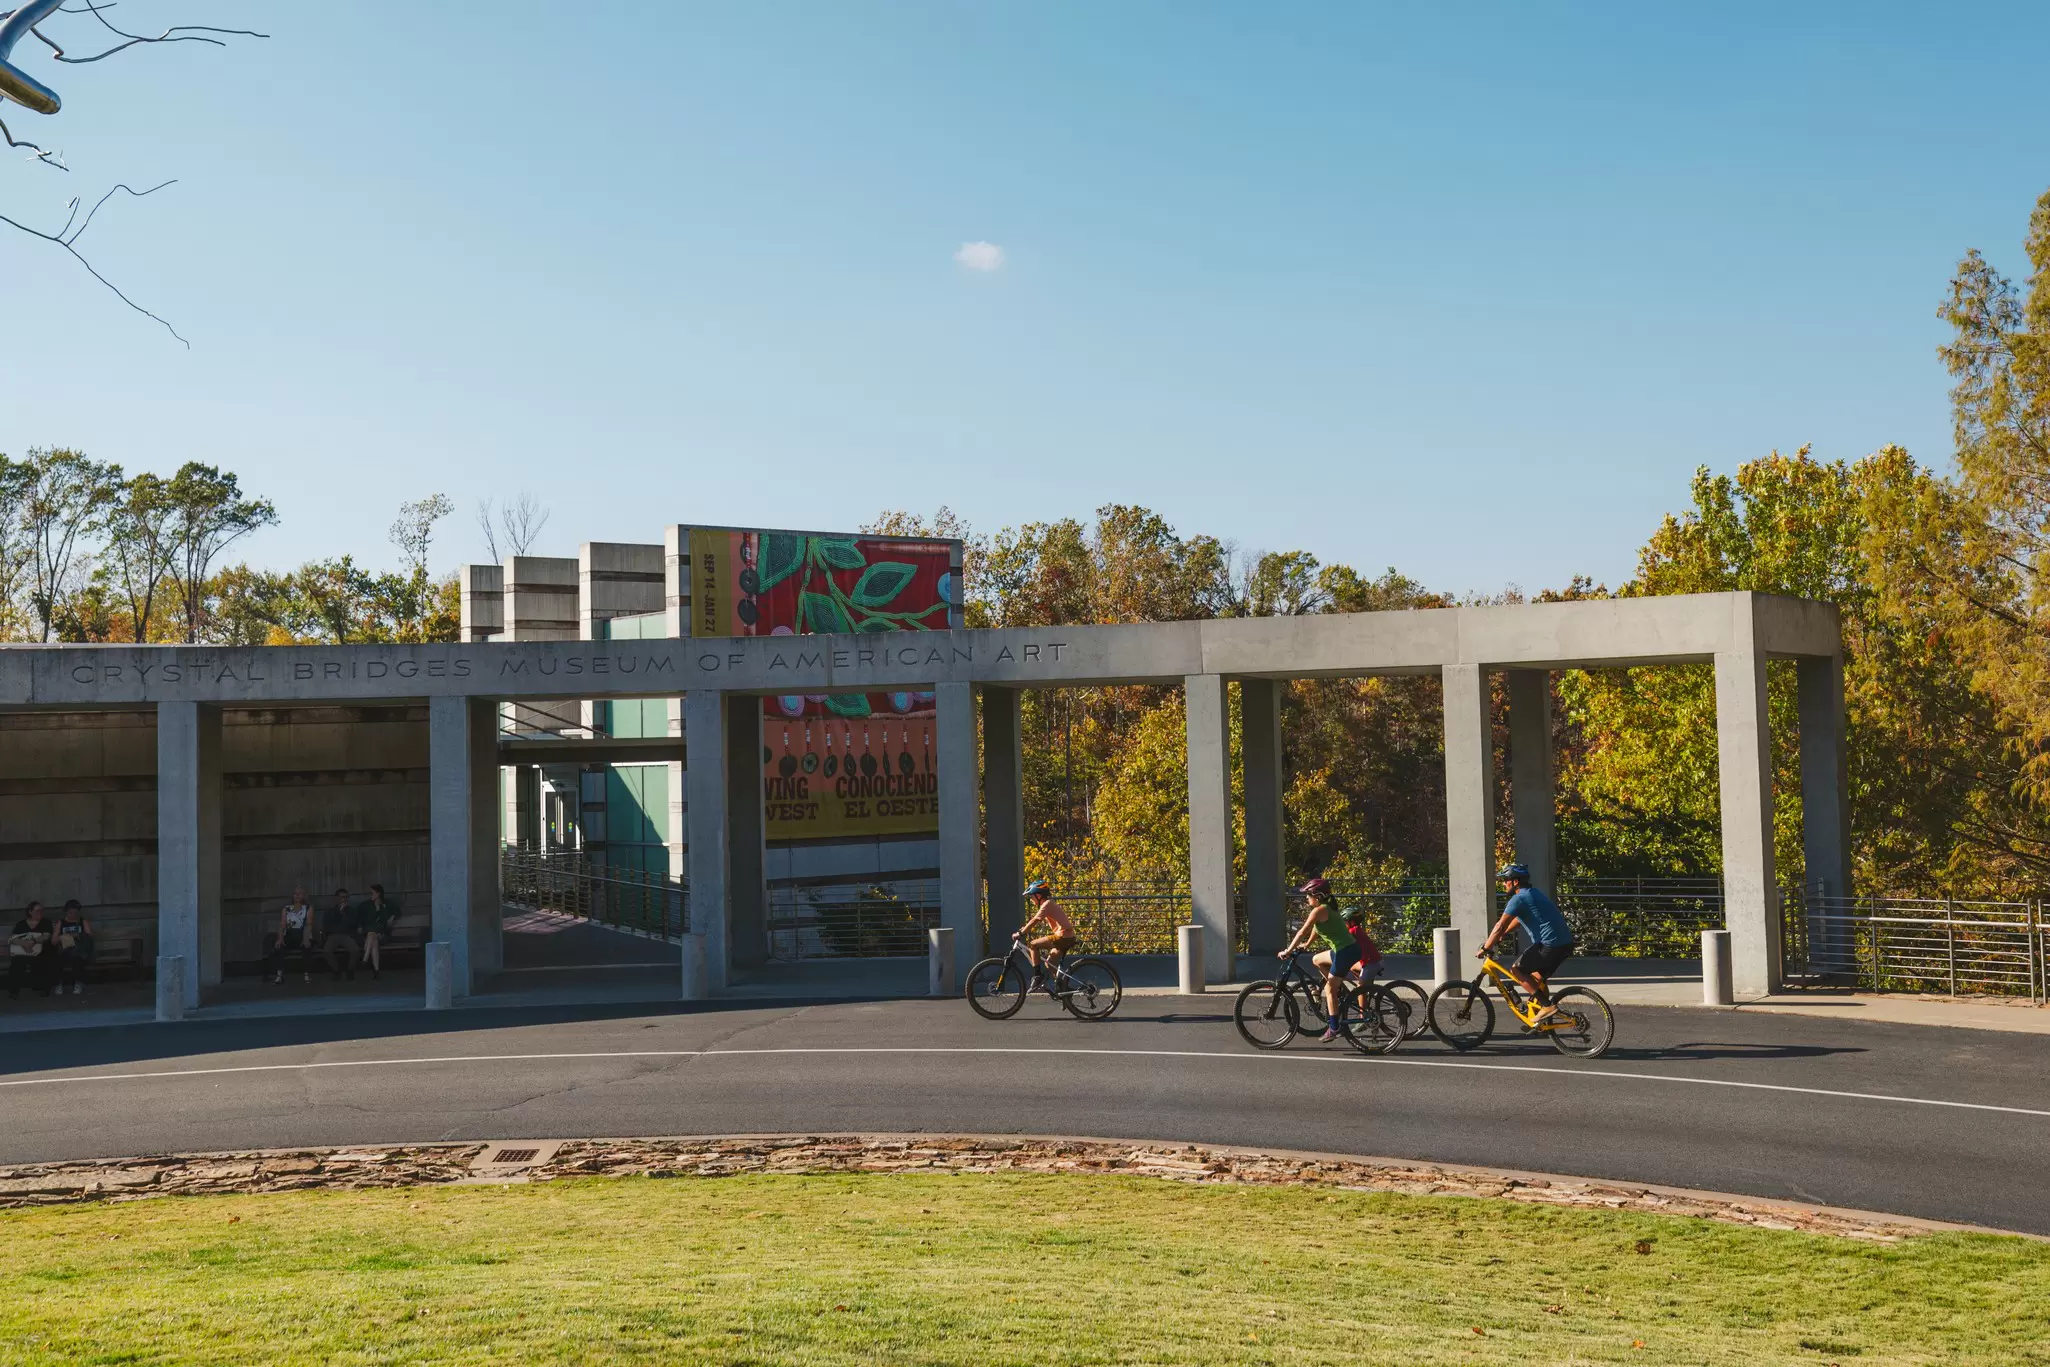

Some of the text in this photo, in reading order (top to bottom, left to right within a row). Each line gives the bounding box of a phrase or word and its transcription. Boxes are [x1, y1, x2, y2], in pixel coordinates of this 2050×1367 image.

[703, 553, 714, 573] SEP
[704, 618, 716, 633] 27
[71, 643, 1068, 684] CRYSTAL BRIDGES MUSEUM OF AMERICAN ART
[844, 798, 938, 819] EL OESTE
